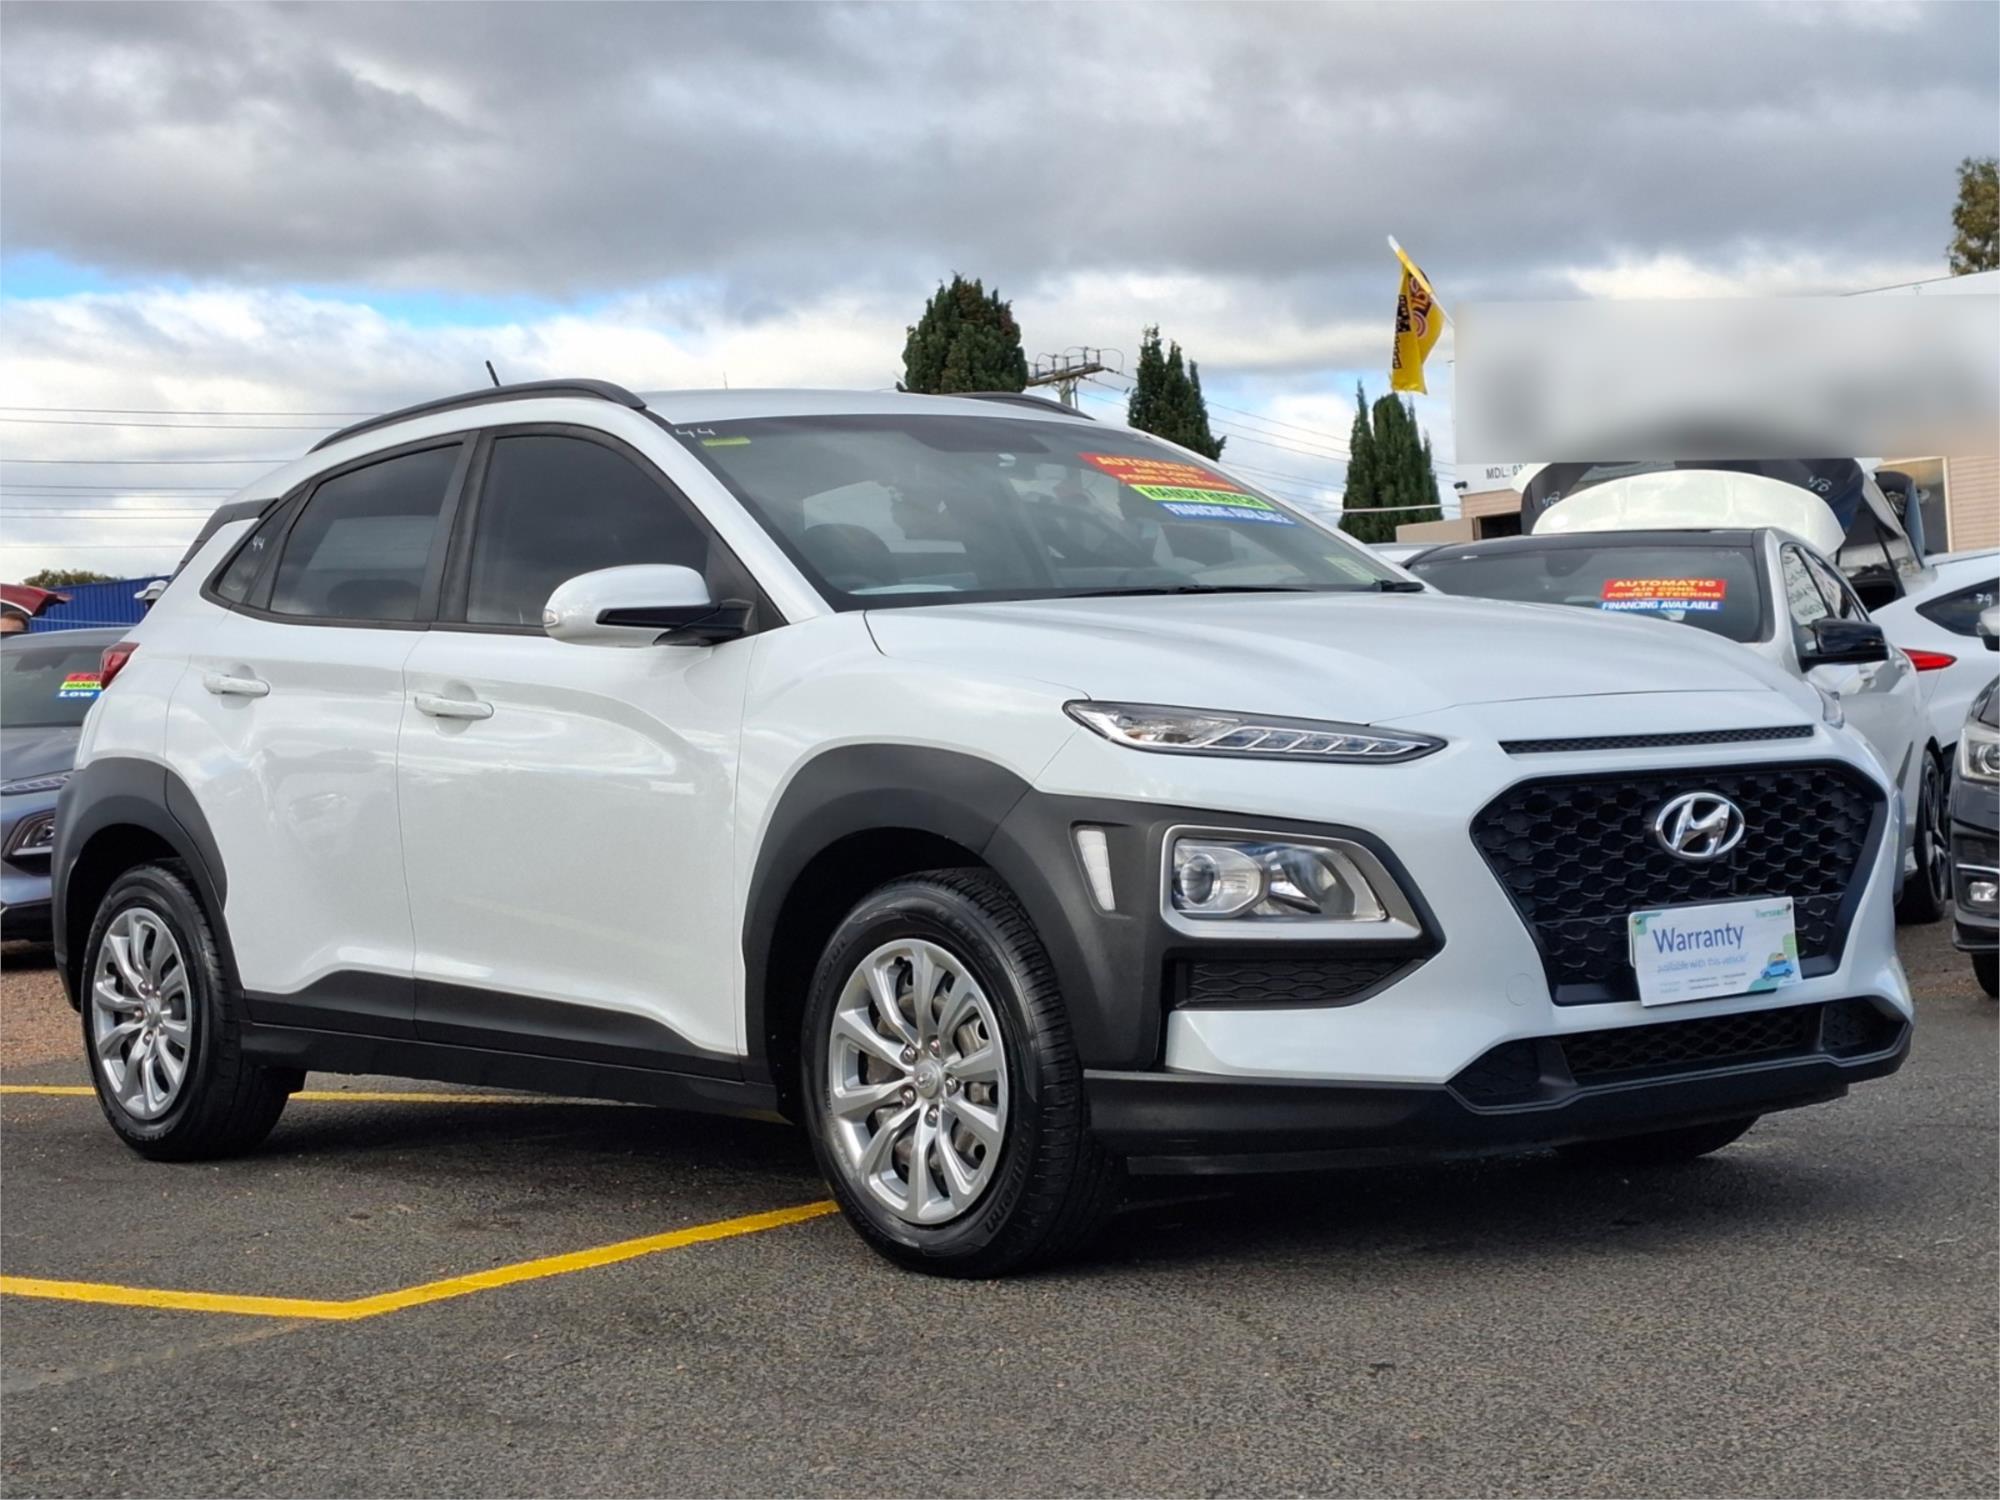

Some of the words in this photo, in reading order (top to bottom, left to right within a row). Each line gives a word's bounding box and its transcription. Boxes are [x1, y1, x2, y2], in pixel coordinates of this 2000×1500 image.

[1613, 580, 1717, 588] AUTOMATIC
[1601, 601, 1658, 611] FINANCING
[1660, 600, 1719, 611] AVAILABLE
[1652, 922, 1745, 954] Warranty
